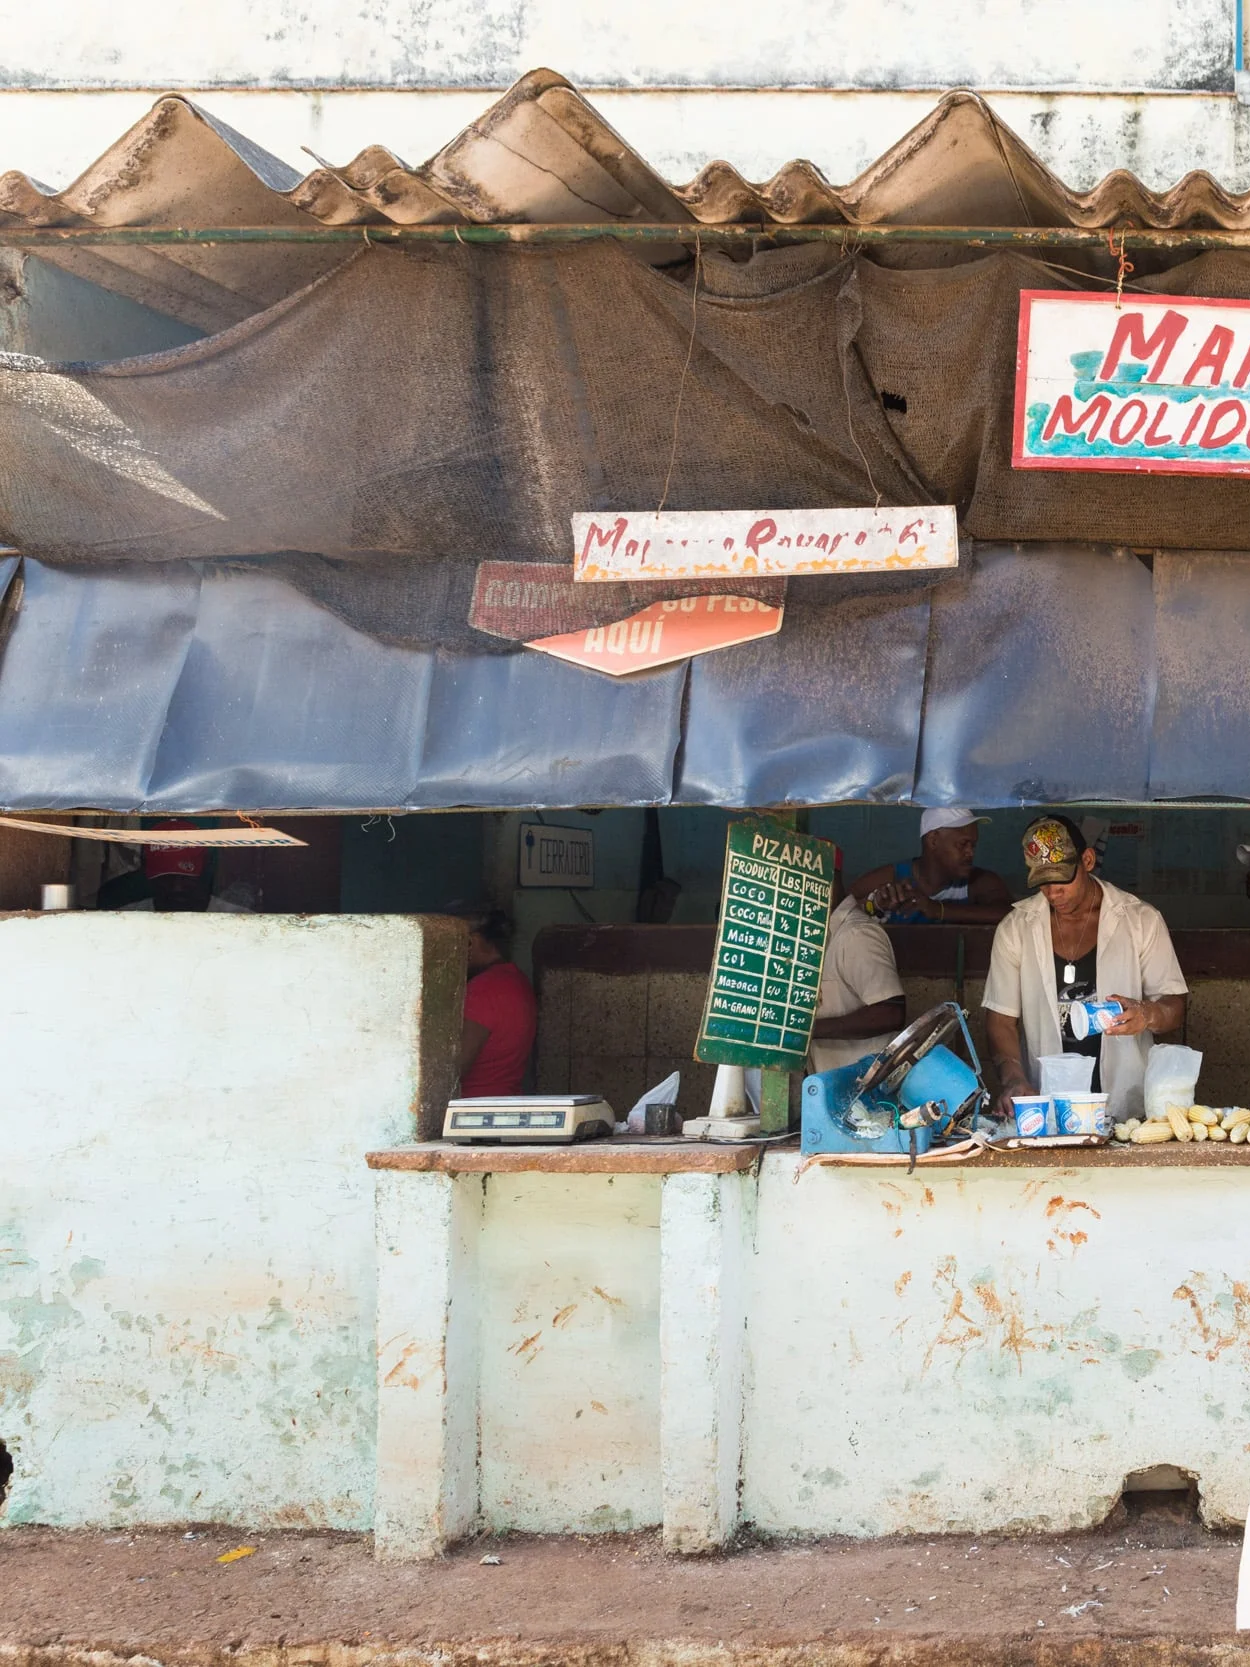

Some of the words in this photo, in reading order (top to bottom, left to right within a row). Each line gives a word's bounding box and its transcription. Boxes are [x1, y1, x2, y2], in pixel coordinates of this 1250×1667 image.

[583, 615, 664, 655] AQUÍ
[752, 834, 824, 875] PIZARRA
[732, 858, 778, 883] PRODUCTO
[781, 871, 802, 892] LBS.
